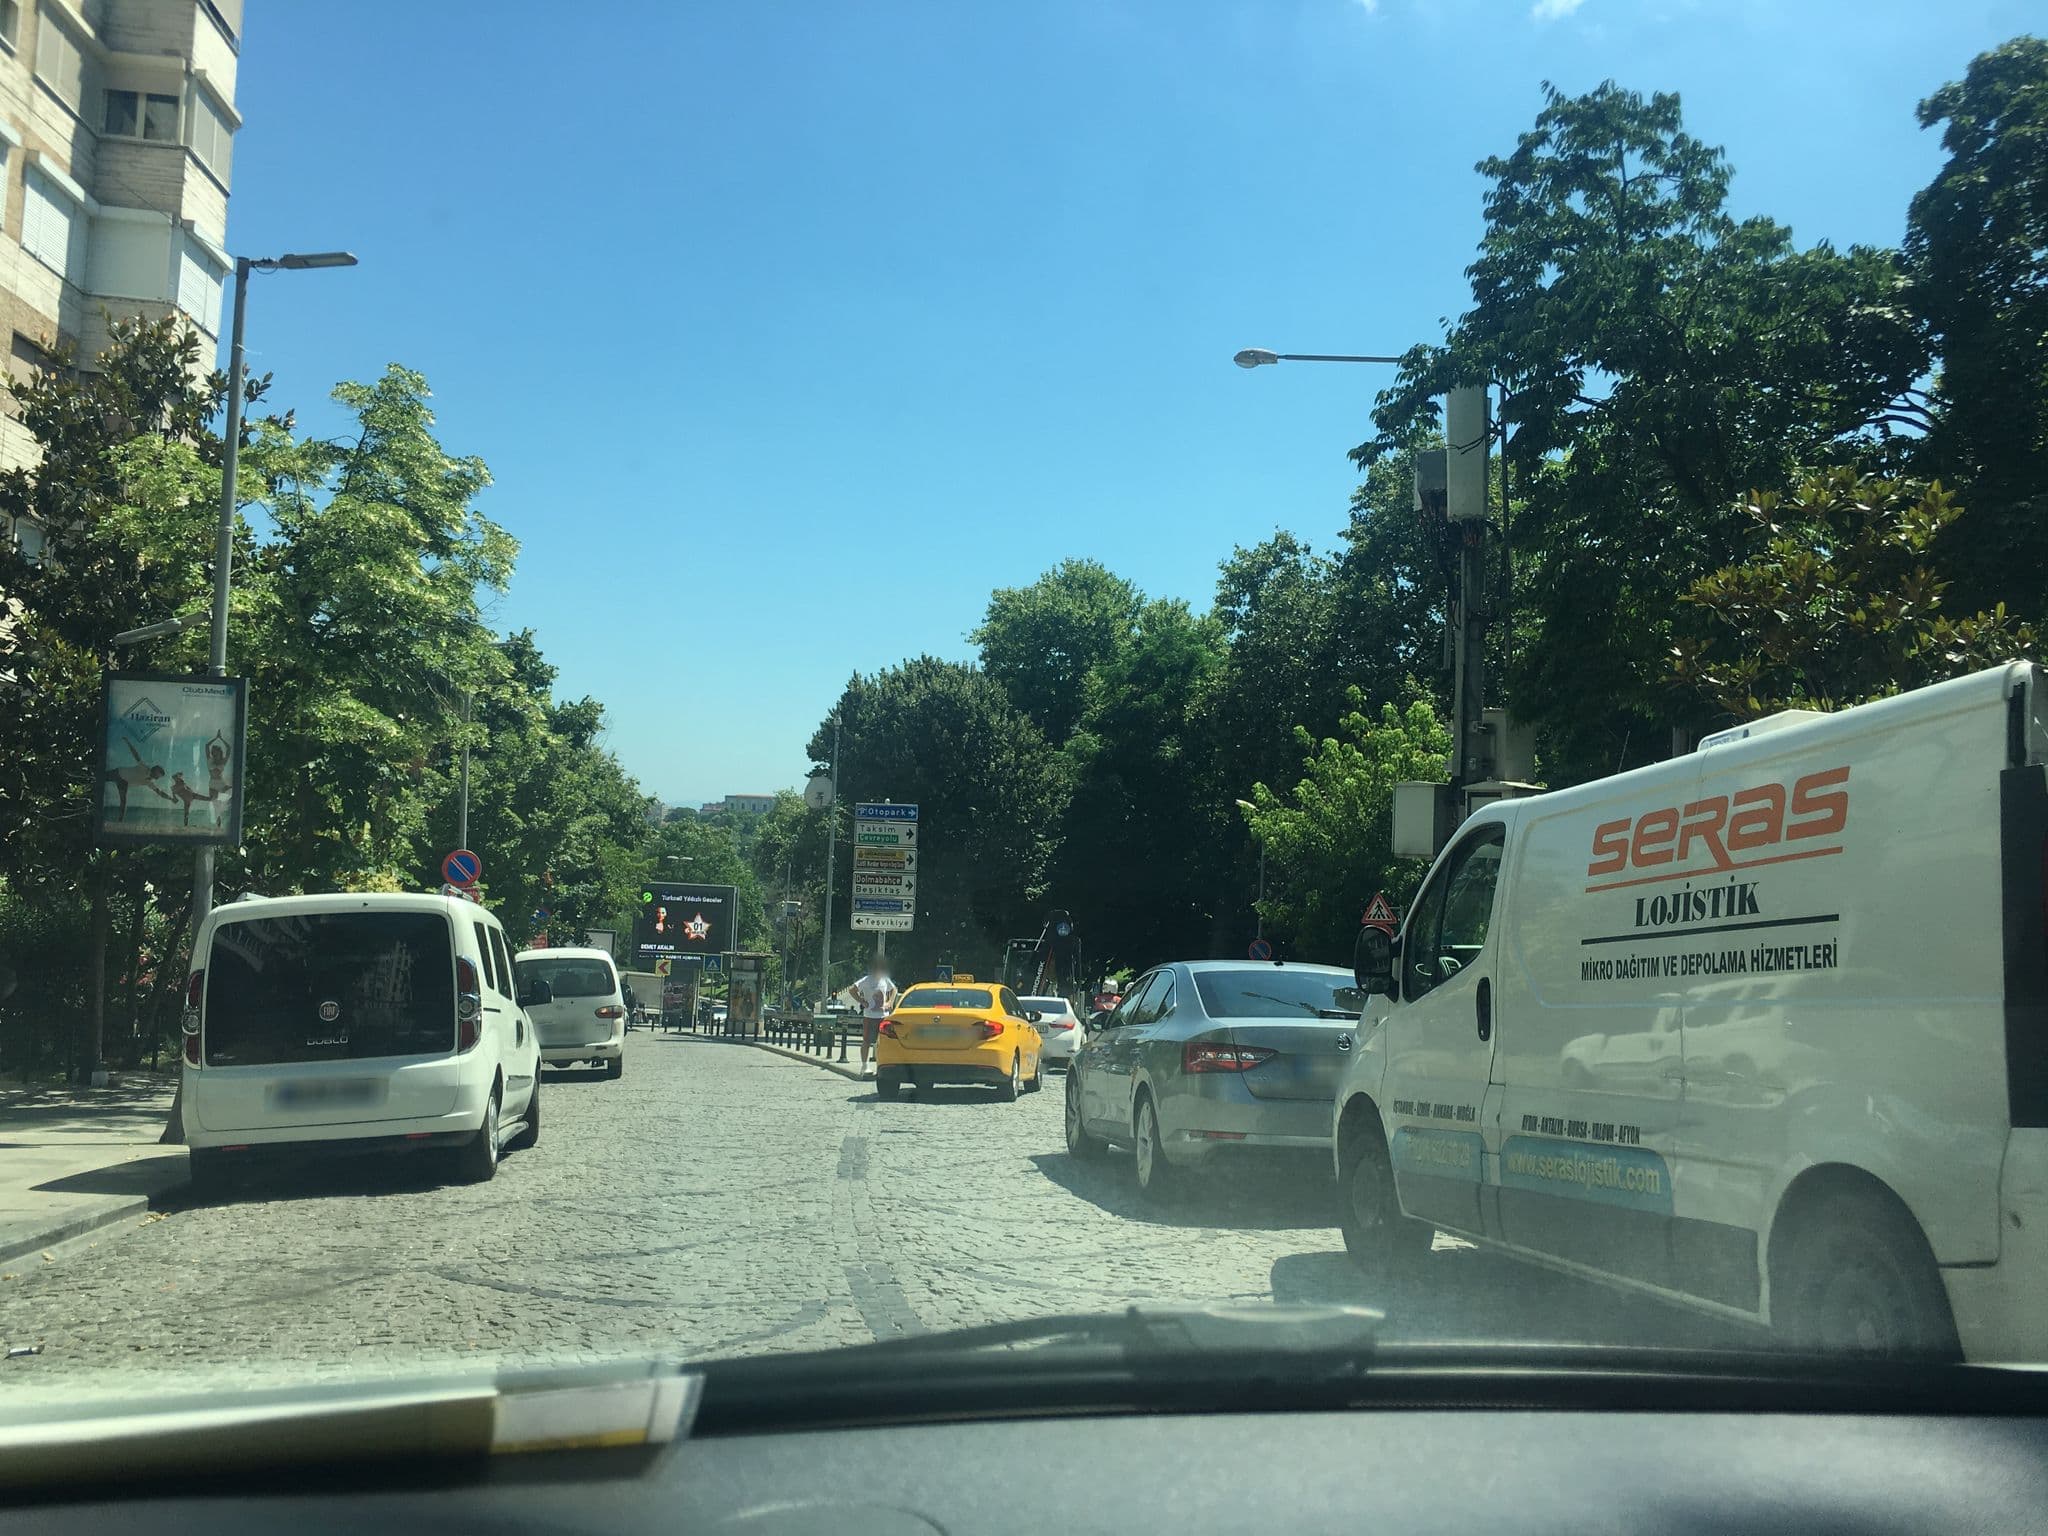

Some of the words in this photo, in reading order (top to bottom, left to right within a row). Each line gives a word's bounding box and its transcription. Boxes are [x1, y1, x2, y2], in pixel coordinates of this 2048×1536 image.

[204, 687, 225, 695] Med
[130, 712, 171, 723] Haziran
[868, 808, 905, 816] Otopark
[860, 824, 896, 833] Taksim
[856, 874, 901, 884] Dolmabahçe
[855, 885, 901, 895] Beşiktaş
[1635, 875, 1760, 927] LOJİSTİK
[693, 922, 703, 931] 01
[865, 918, 908, 928] Teşvikiye
[1581, 957, 1613, 981] MİKRO
[1615, 953, 1660, 979] DAĞITIM
[1663, 955, 1678, 977] VE
[1681, 950, 1747, 976] DEPOLAMA
[1750, 937, 1838, 972] HİZMETLERİ
[323, 1006, 336, 1017] FIAT
[1617, 1124, 1641, 1145] AFYON
[1507, 1151, 1661, 1194] www.seraslojistik.com
